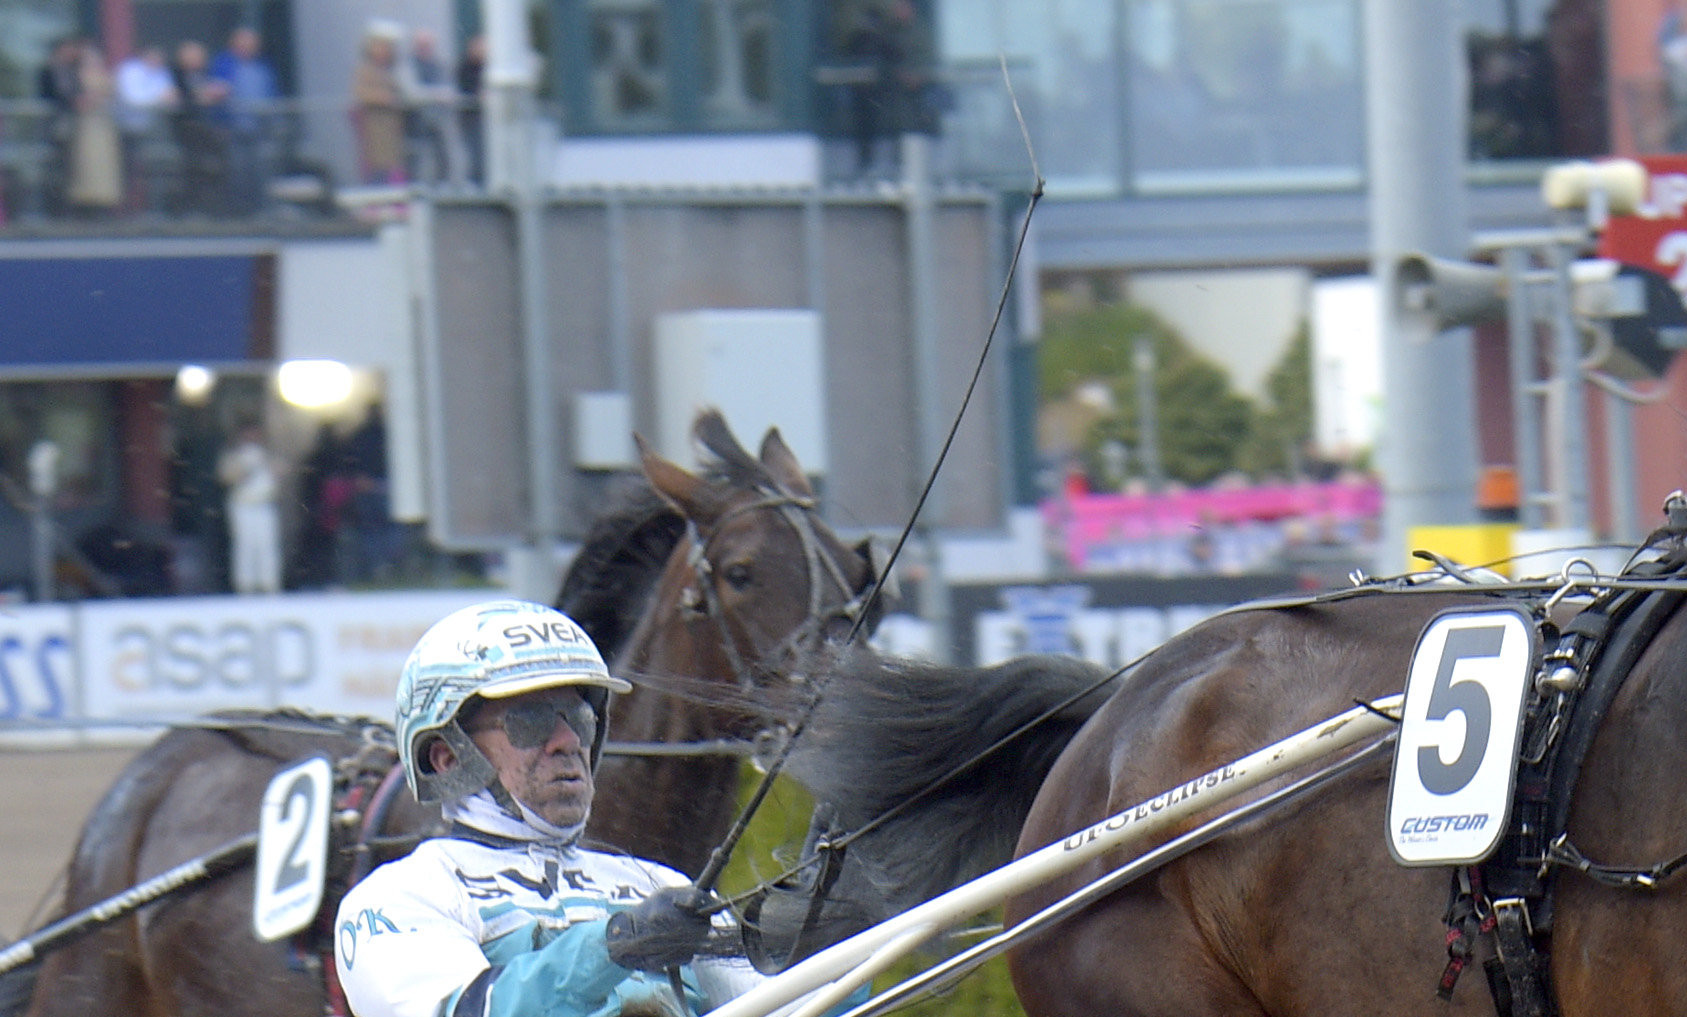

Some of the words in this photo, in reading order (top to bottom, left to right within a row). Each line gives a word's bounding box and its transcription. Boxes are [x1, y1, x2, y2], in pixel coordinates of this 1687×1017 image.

[111, 620, 317, 707] asap
[503, 622, 588, 649] SVEA
[1417, 625, 1507, 796] 5
[273, 772, 317, 896] 2
[1400, 812, 1489, 834] CUSTOM
